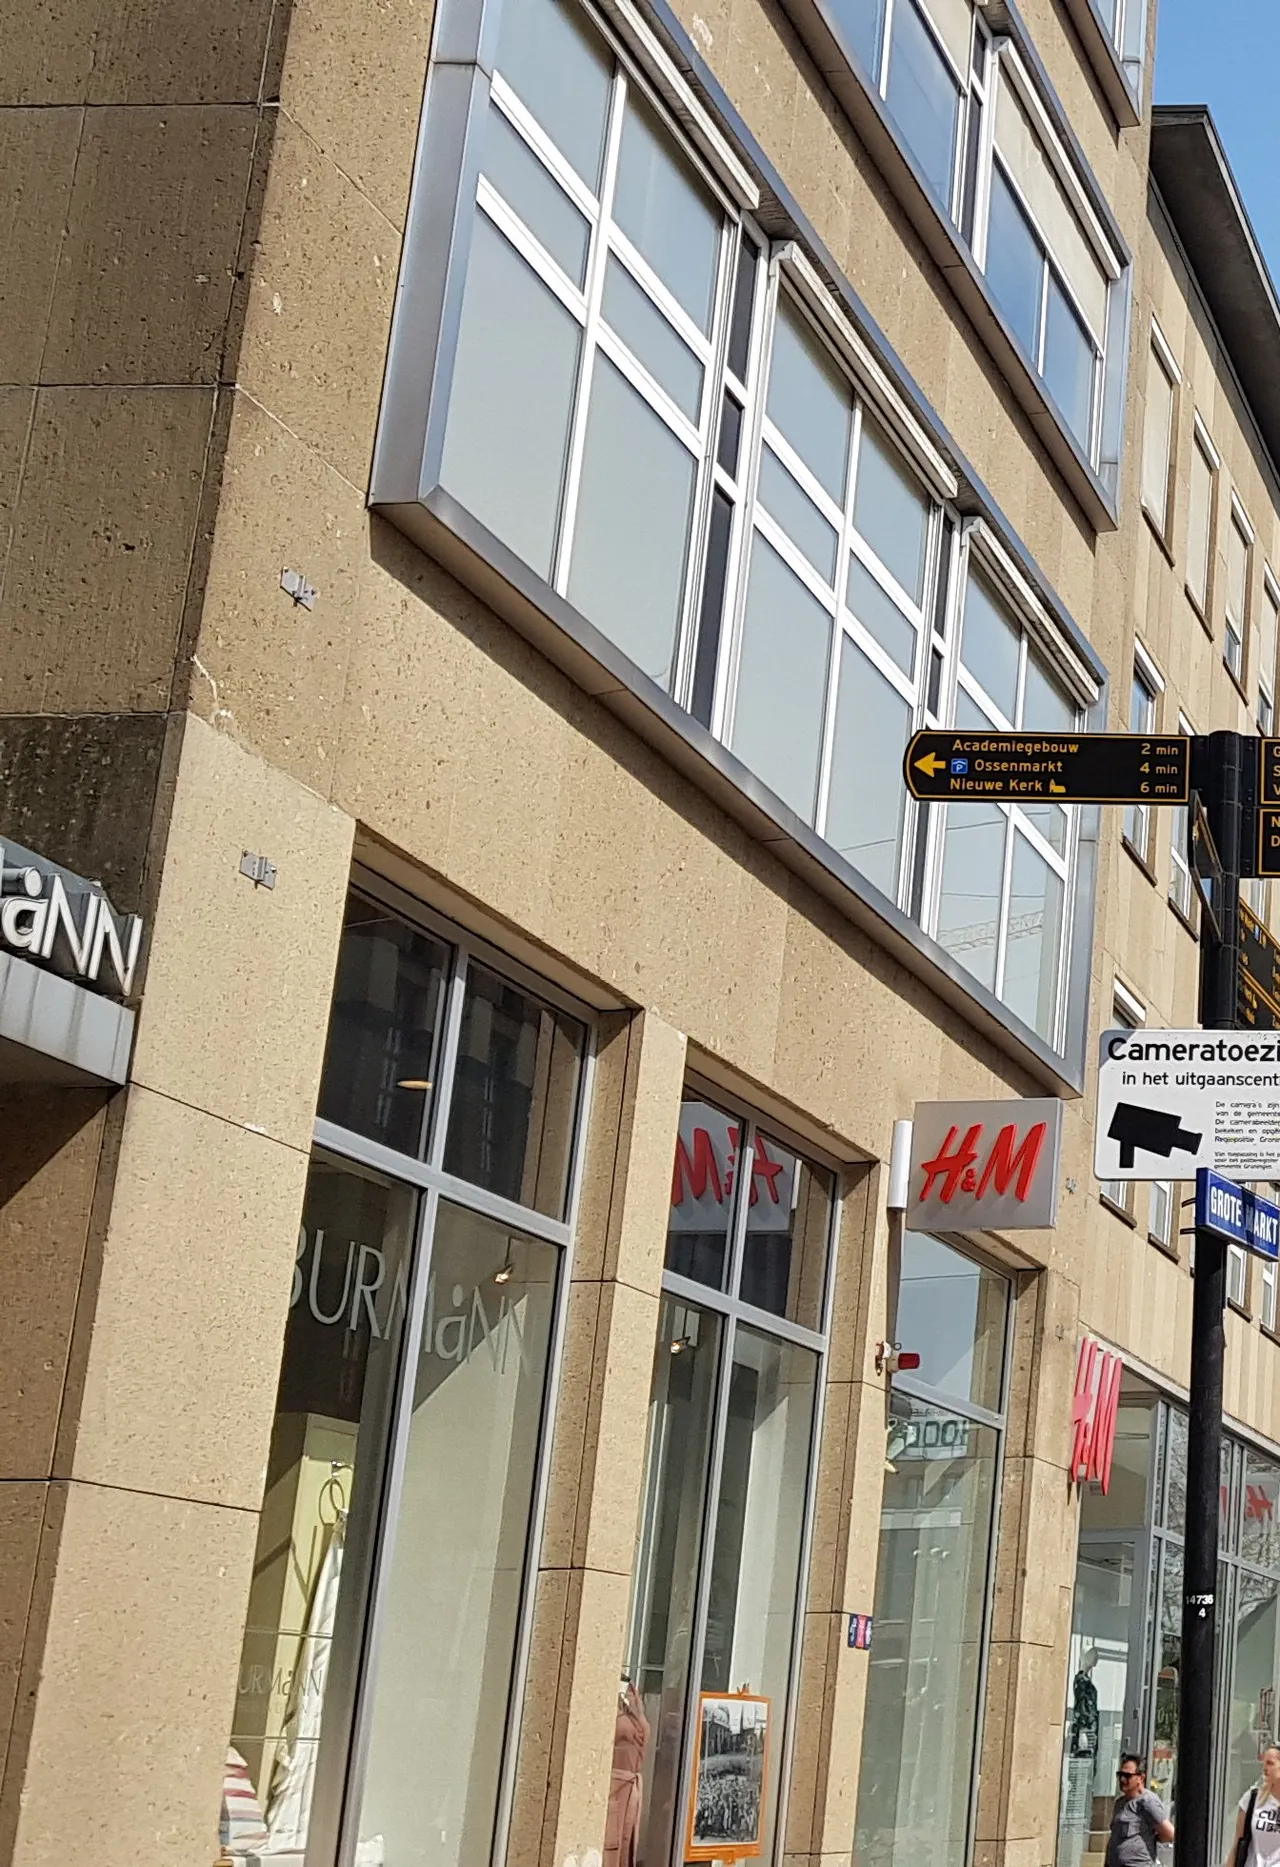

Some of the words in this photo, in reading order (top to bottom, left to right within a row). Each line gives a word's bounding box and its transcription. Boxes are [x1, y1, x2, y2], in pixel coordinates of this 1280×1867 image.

[952, 739, 1079, 756] Academiegebouw
[1141, 743, 1150, 755] 2
[1156, 744, 1179, 756] min
[974, 759, 1062, 773] Ossenmarkt
[1140, 762, 1150, 774] 4
[1155, 763, 1178, 774] min
[950, 778, 1003, 791] Nieuwe
[1009, 779, 1042, 792] Kerk
[1140, 781, 1149, 793] 6
[1155, 782, 1177, 794] min
[1122, 1071, 1136, 1085] in
[1142, 1071, 1169, 1086] het
[919, 1121, 1047, 1204] H&M
[1211, 1186, 1242, 1227] GROTE
[1198, 1607, 1206, 1618] 4
